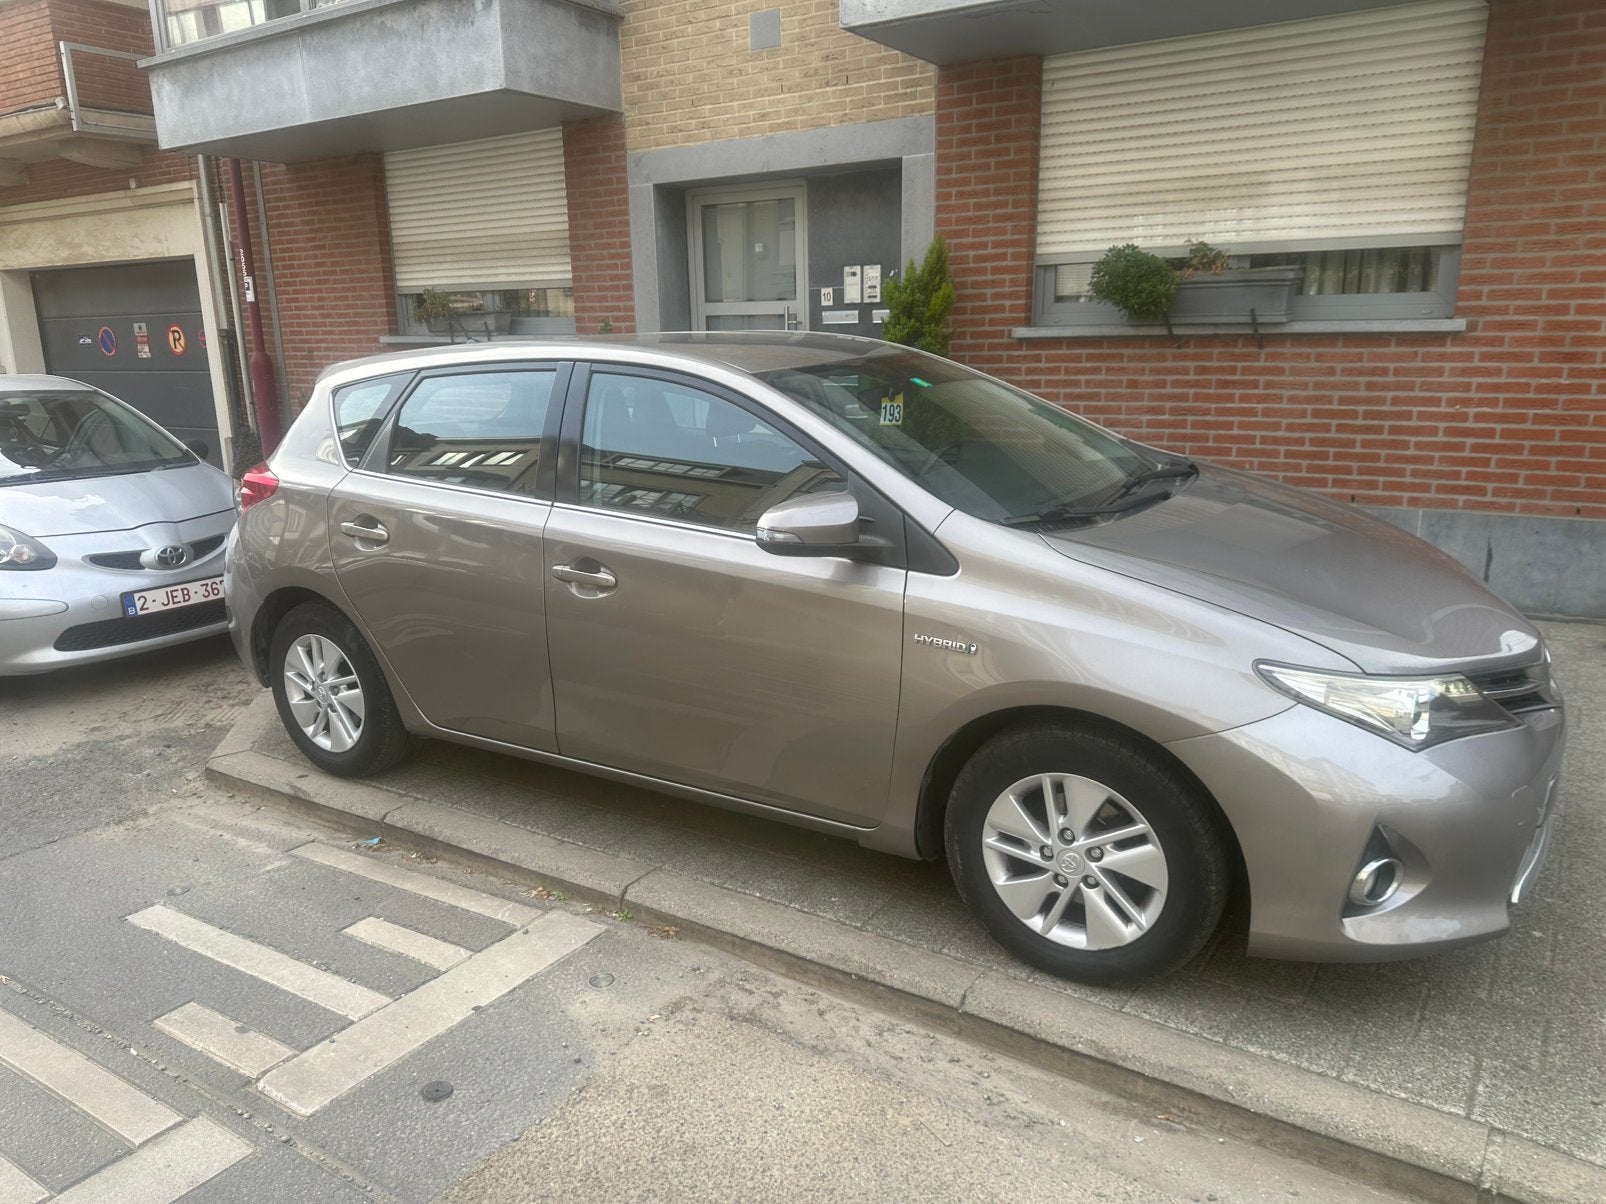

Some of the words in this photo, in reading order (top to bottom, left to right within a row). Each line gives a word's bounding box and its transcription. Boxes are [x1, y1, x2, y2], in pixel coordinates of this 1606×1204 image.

[822, 292, 831, 302] 10
[171, 329, 181, 349] P
[882, 404, 902, 423] 193
[128, 607, 136, 615] B
[914, 634, 967, 653] HYBRID
